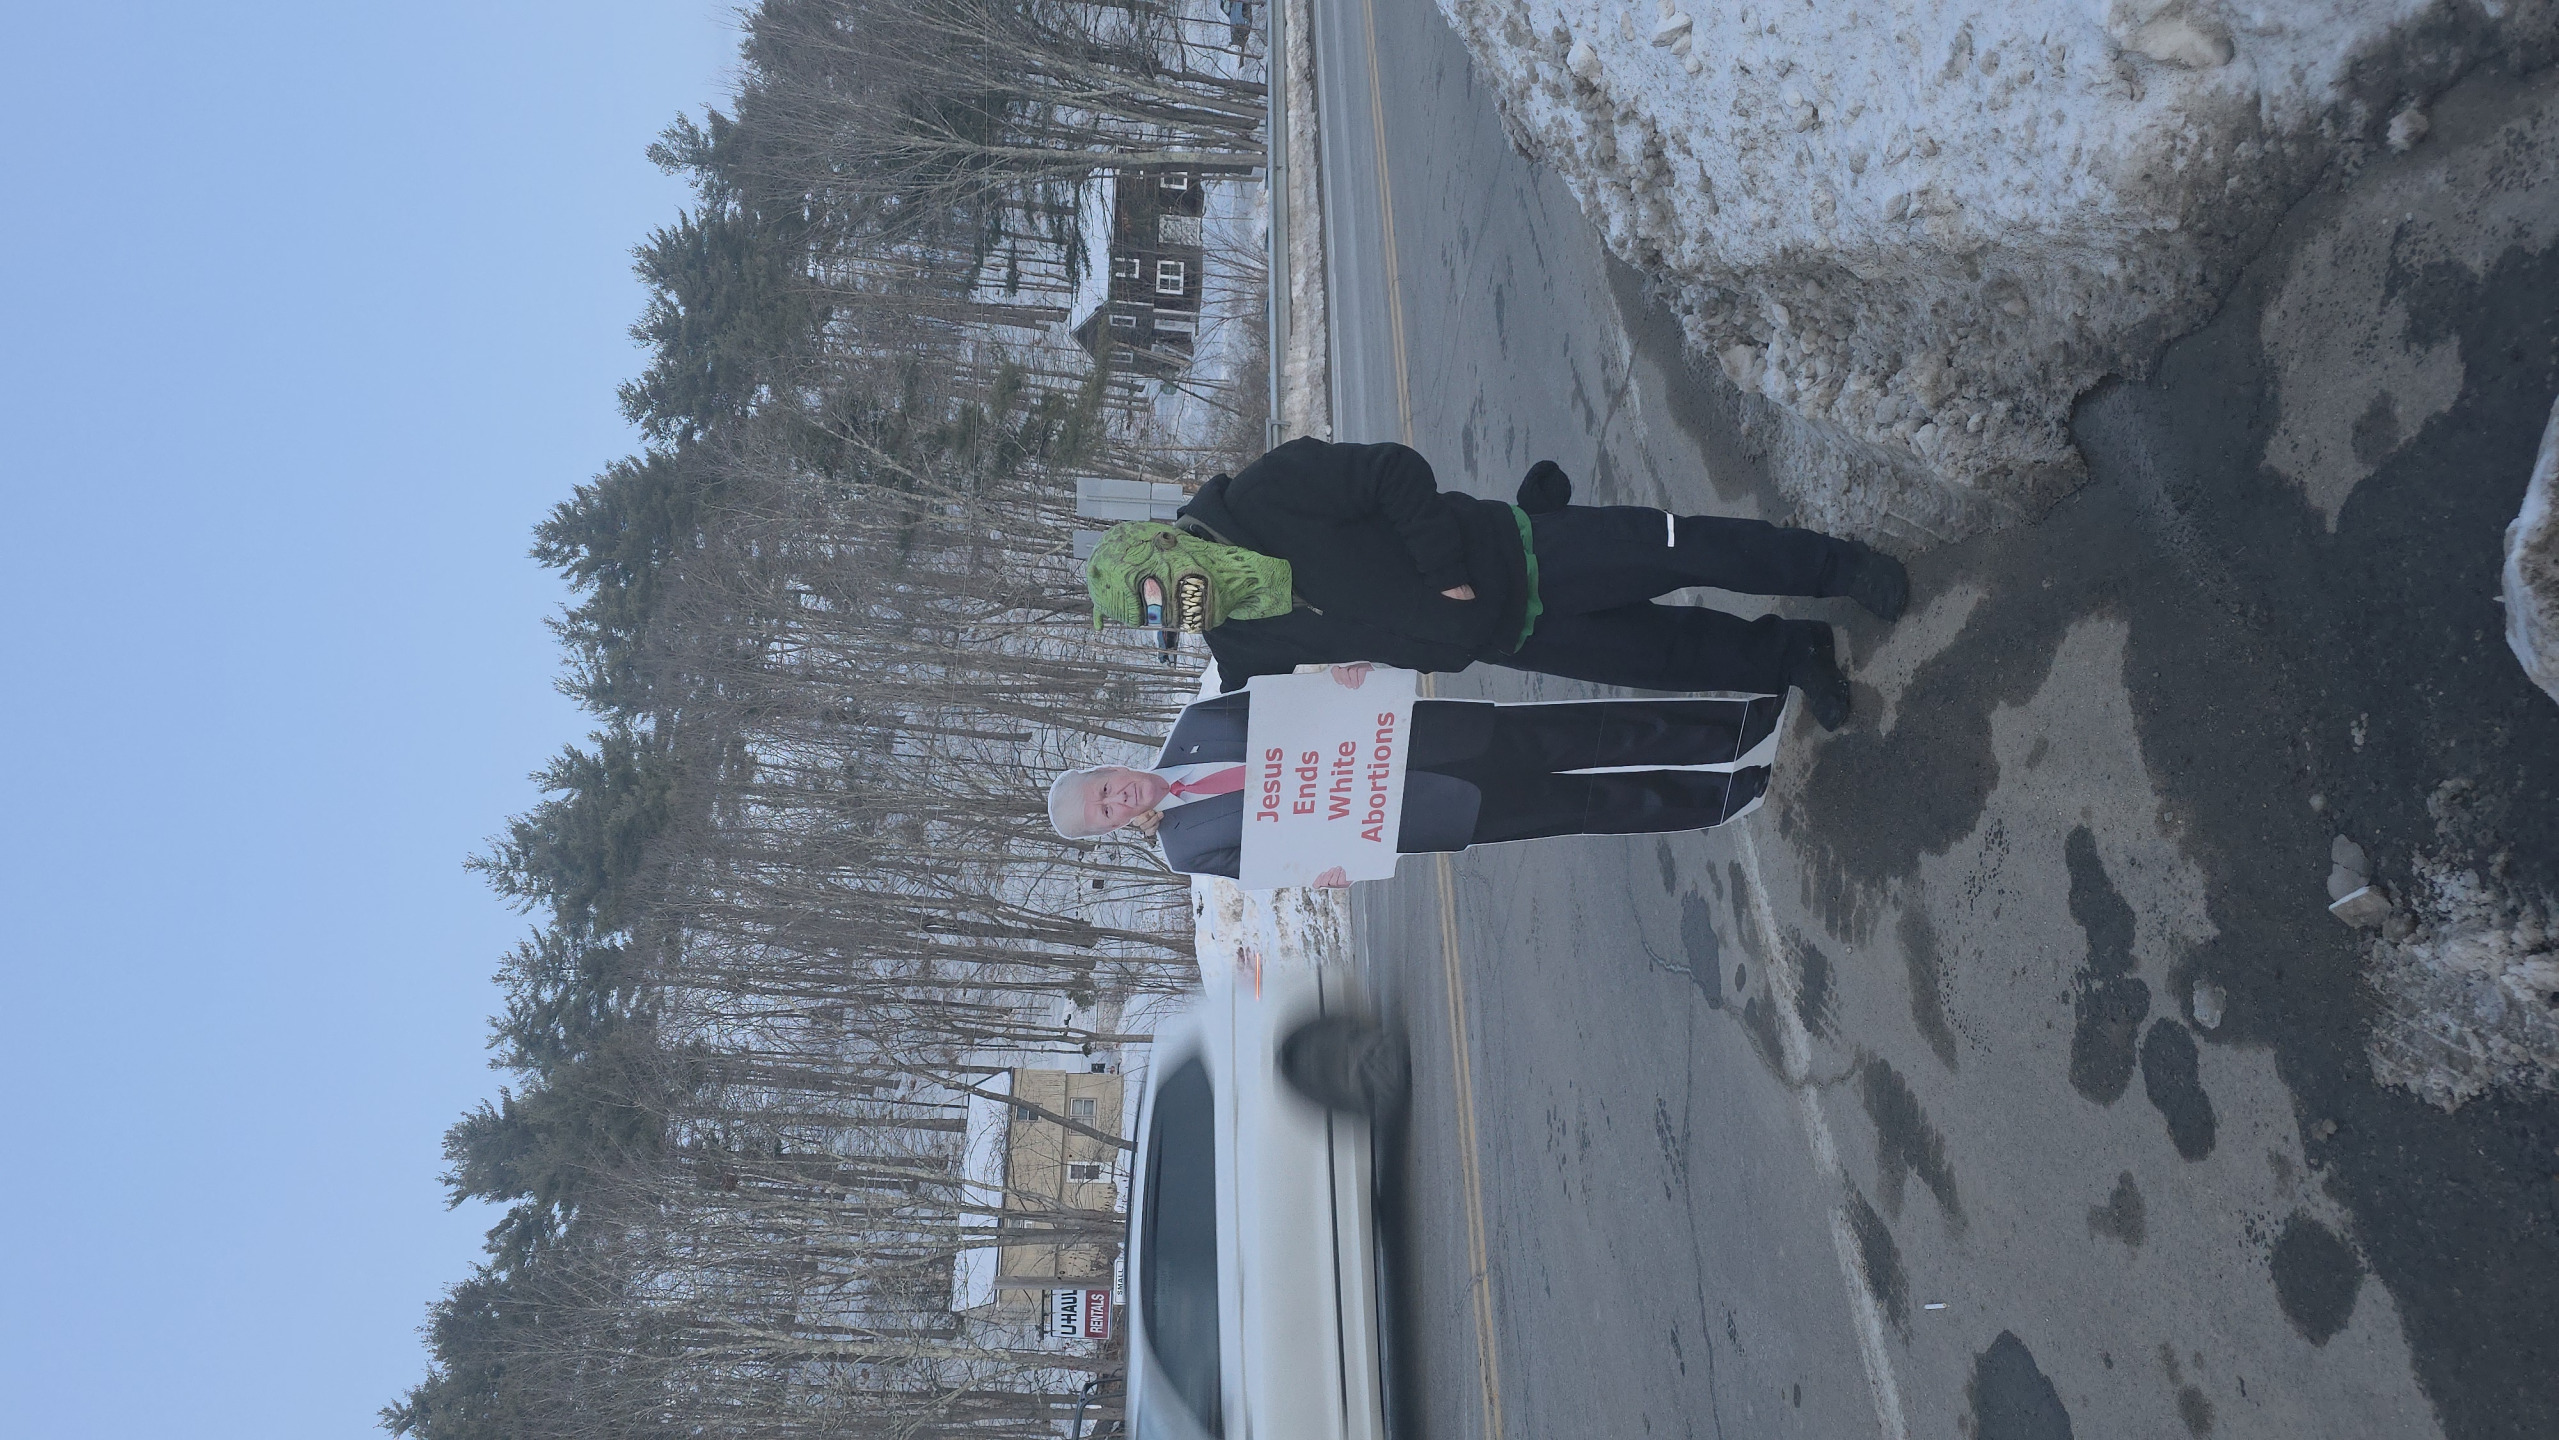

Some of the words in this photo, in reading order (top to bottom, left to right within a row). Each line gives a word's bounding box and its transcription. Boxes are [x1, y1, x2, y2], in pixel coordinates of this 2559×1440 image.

[1256, 748, 1283, 822] Jesus
[1293, 751, 1319, 815] Ends
[1328, 741, 1356, 820] White
[1361, 711, 1394, 842] Abortions
[1090, 1294, 1104, 1333] RENTALS
